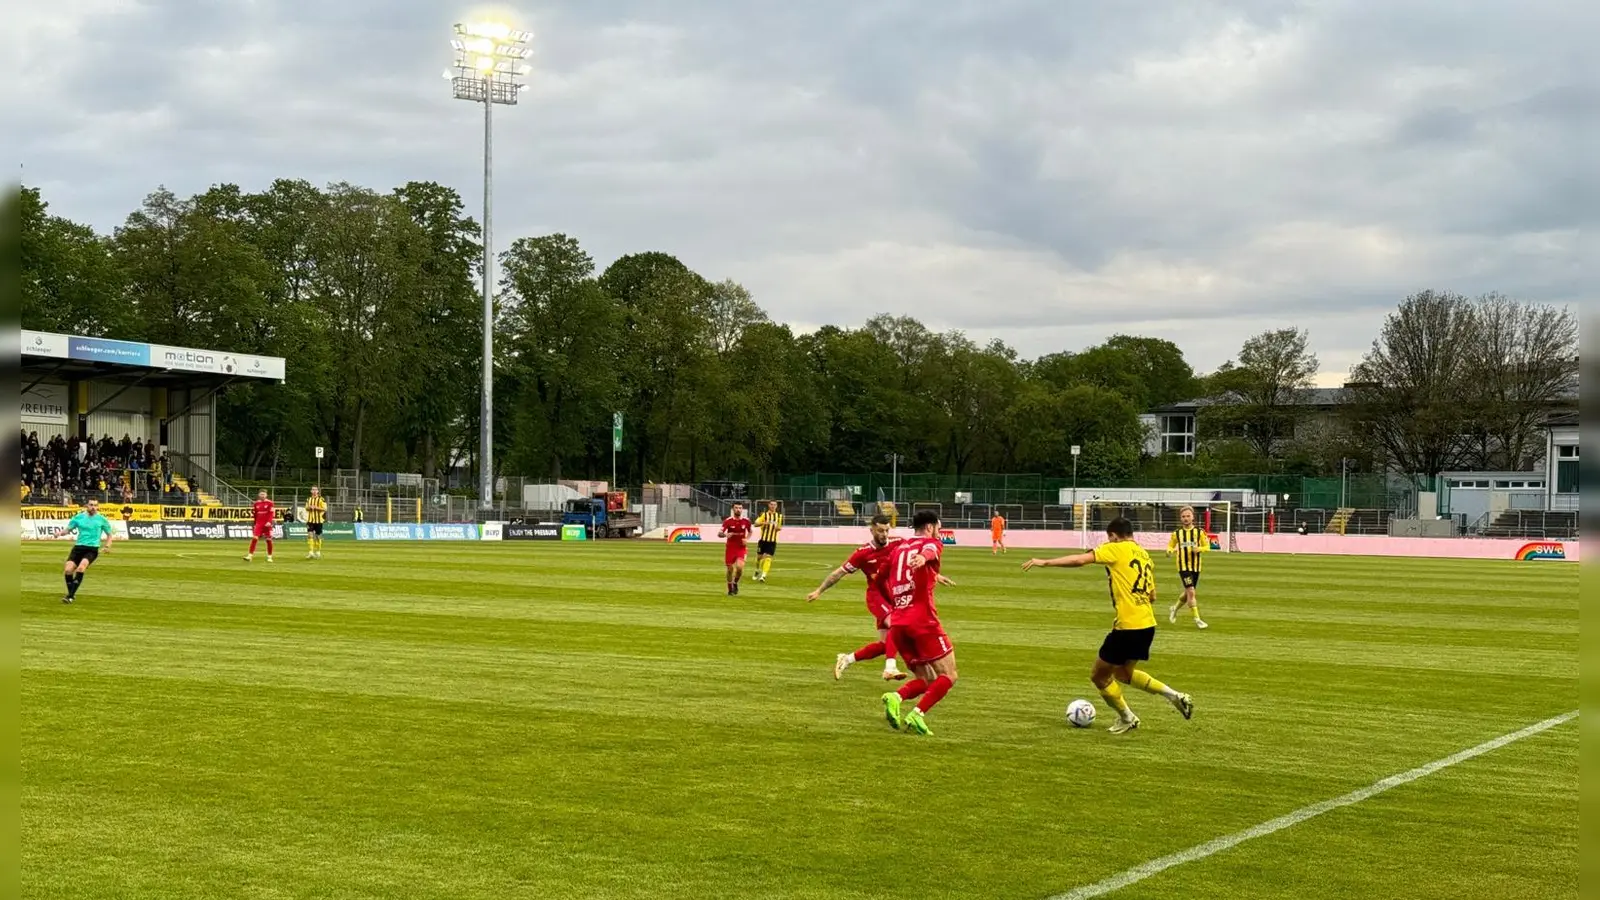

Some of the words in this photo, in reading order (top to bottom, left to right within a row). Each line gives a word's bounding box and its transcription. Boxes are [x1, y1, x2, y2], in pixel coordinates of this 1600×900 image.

[164, 507, 186, 518] NEIN
[191, 508, 203, 518] ZU
[129, 524, 162, 538] capelli
[193, 524, 226, 538] capelli
